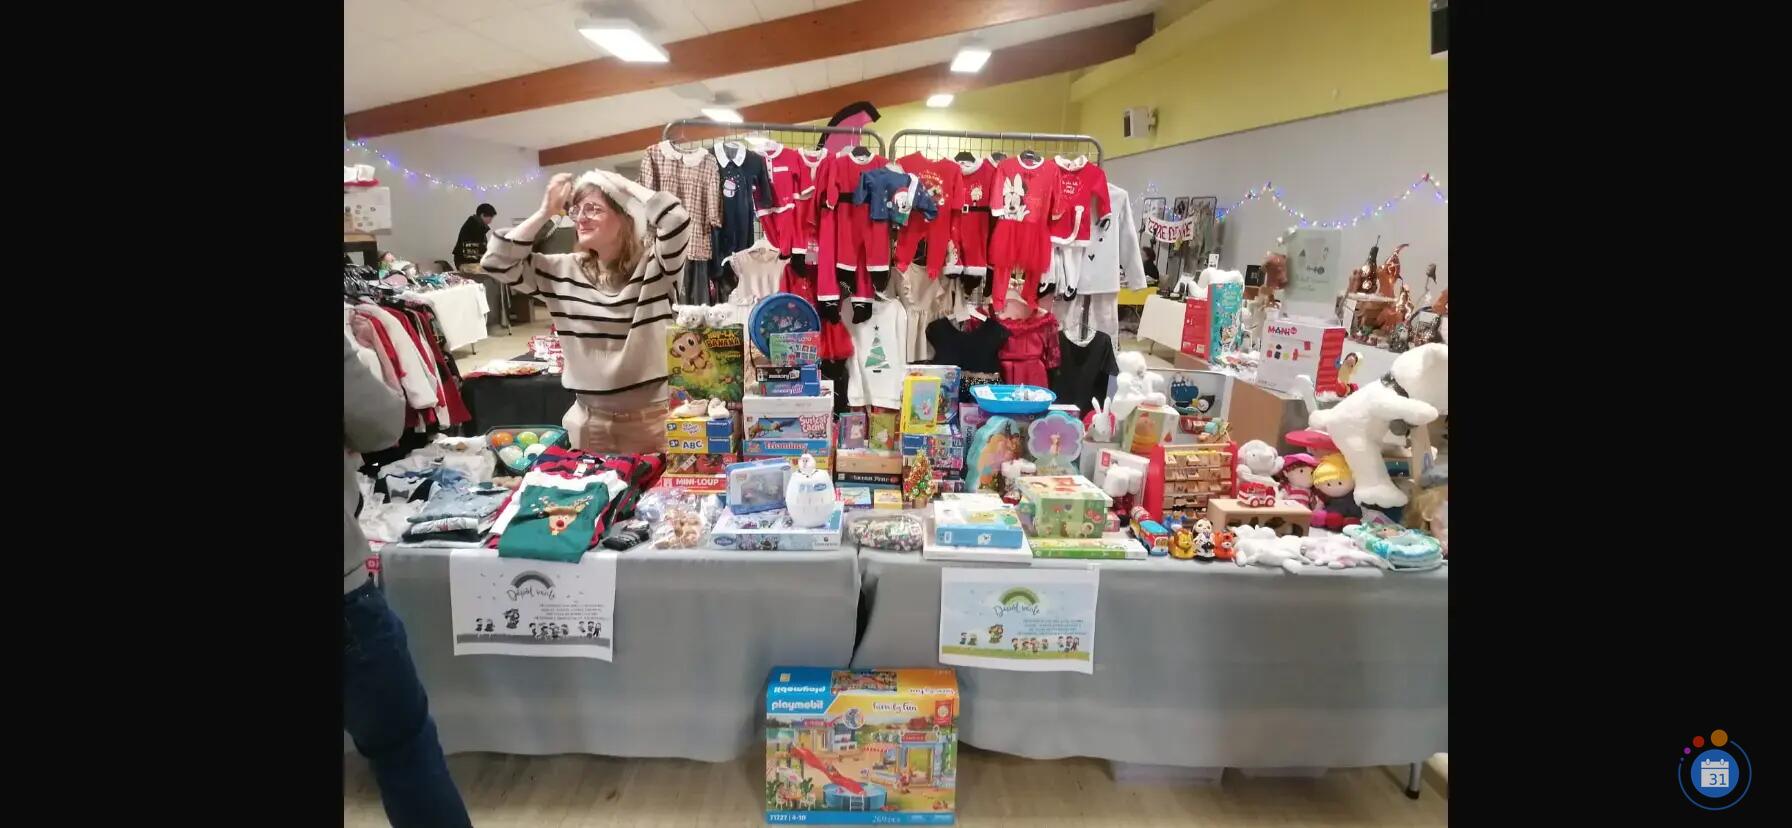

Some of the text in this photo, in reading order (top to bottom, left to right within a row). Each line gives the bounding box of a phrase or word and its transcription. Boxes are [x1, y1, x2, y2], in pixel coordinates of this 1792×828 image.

[683, 441, 703, 449] ABC
[774, 686, 826, 694] playmobil
[771, 700, 824, 711] playmobil
